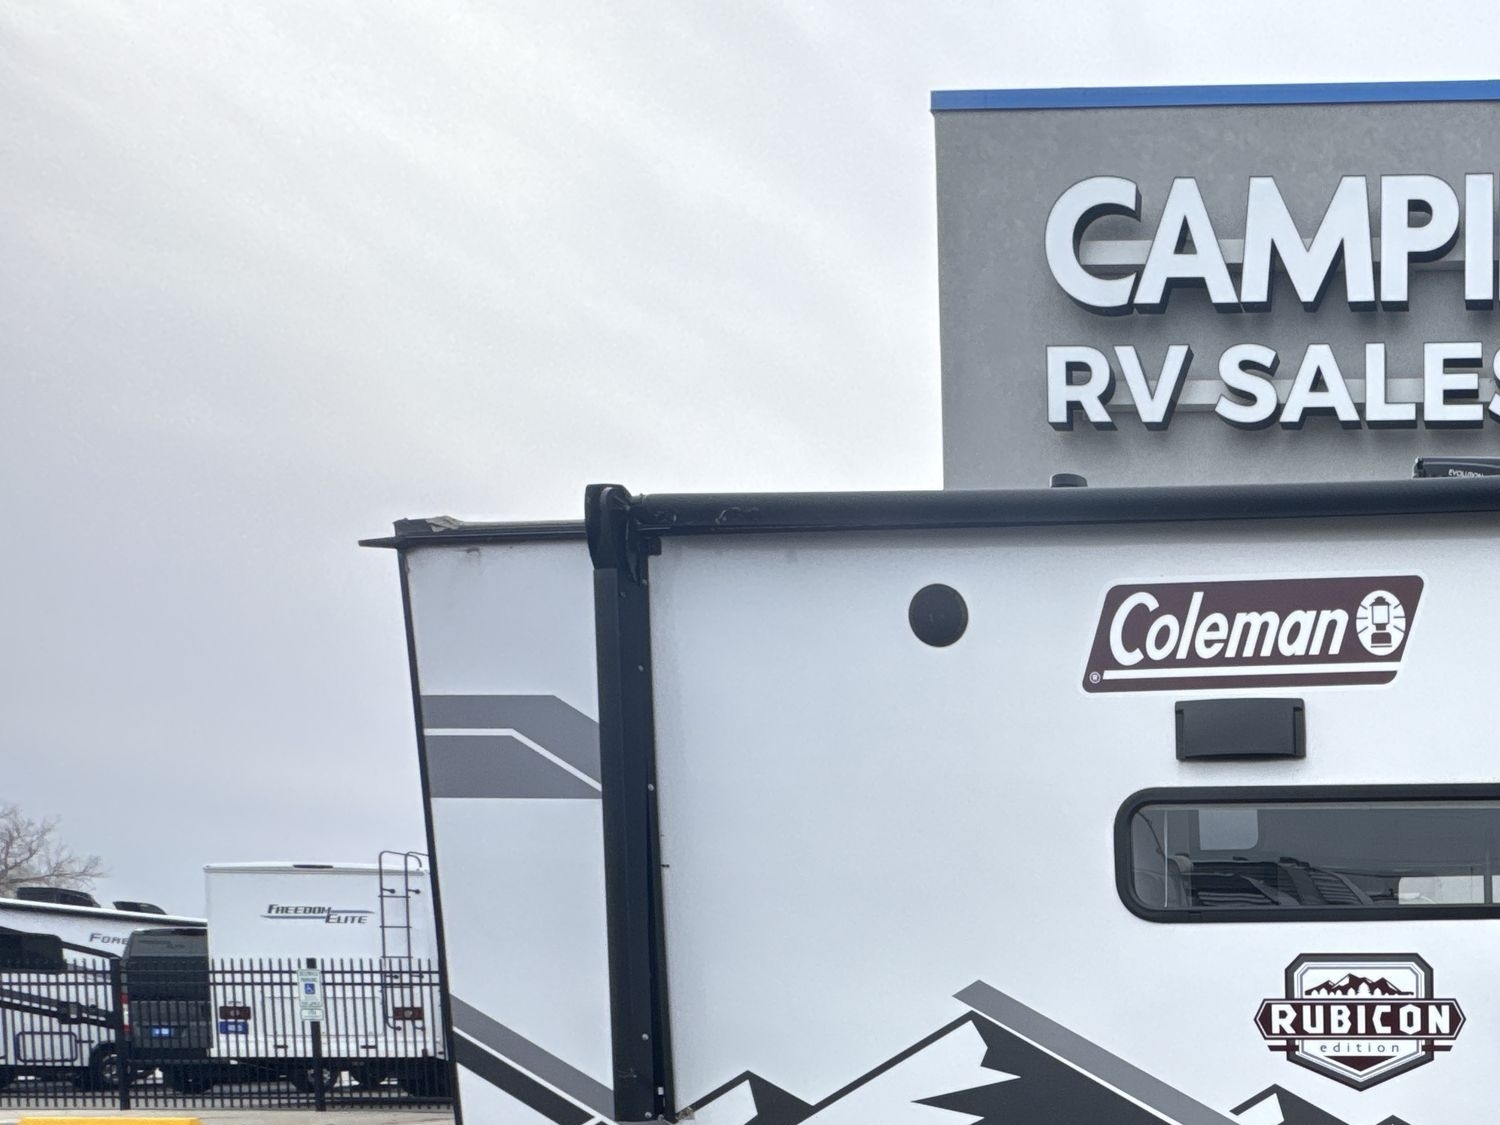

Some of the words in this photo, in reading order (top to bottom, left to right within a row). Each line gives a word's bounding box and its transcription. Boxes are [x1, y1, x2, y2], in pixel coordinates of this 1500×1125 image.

[1046, 343, 1191, 427] RV
[1109, 591, 1349, 666] Coleman
[267, 904, 332, 914] FREEDOM
[325, 914, 368, 924] ELITE
[1270, 1003, 1450, 1035] RUBICON
[1320, 1042, 1400, 1053] edition
